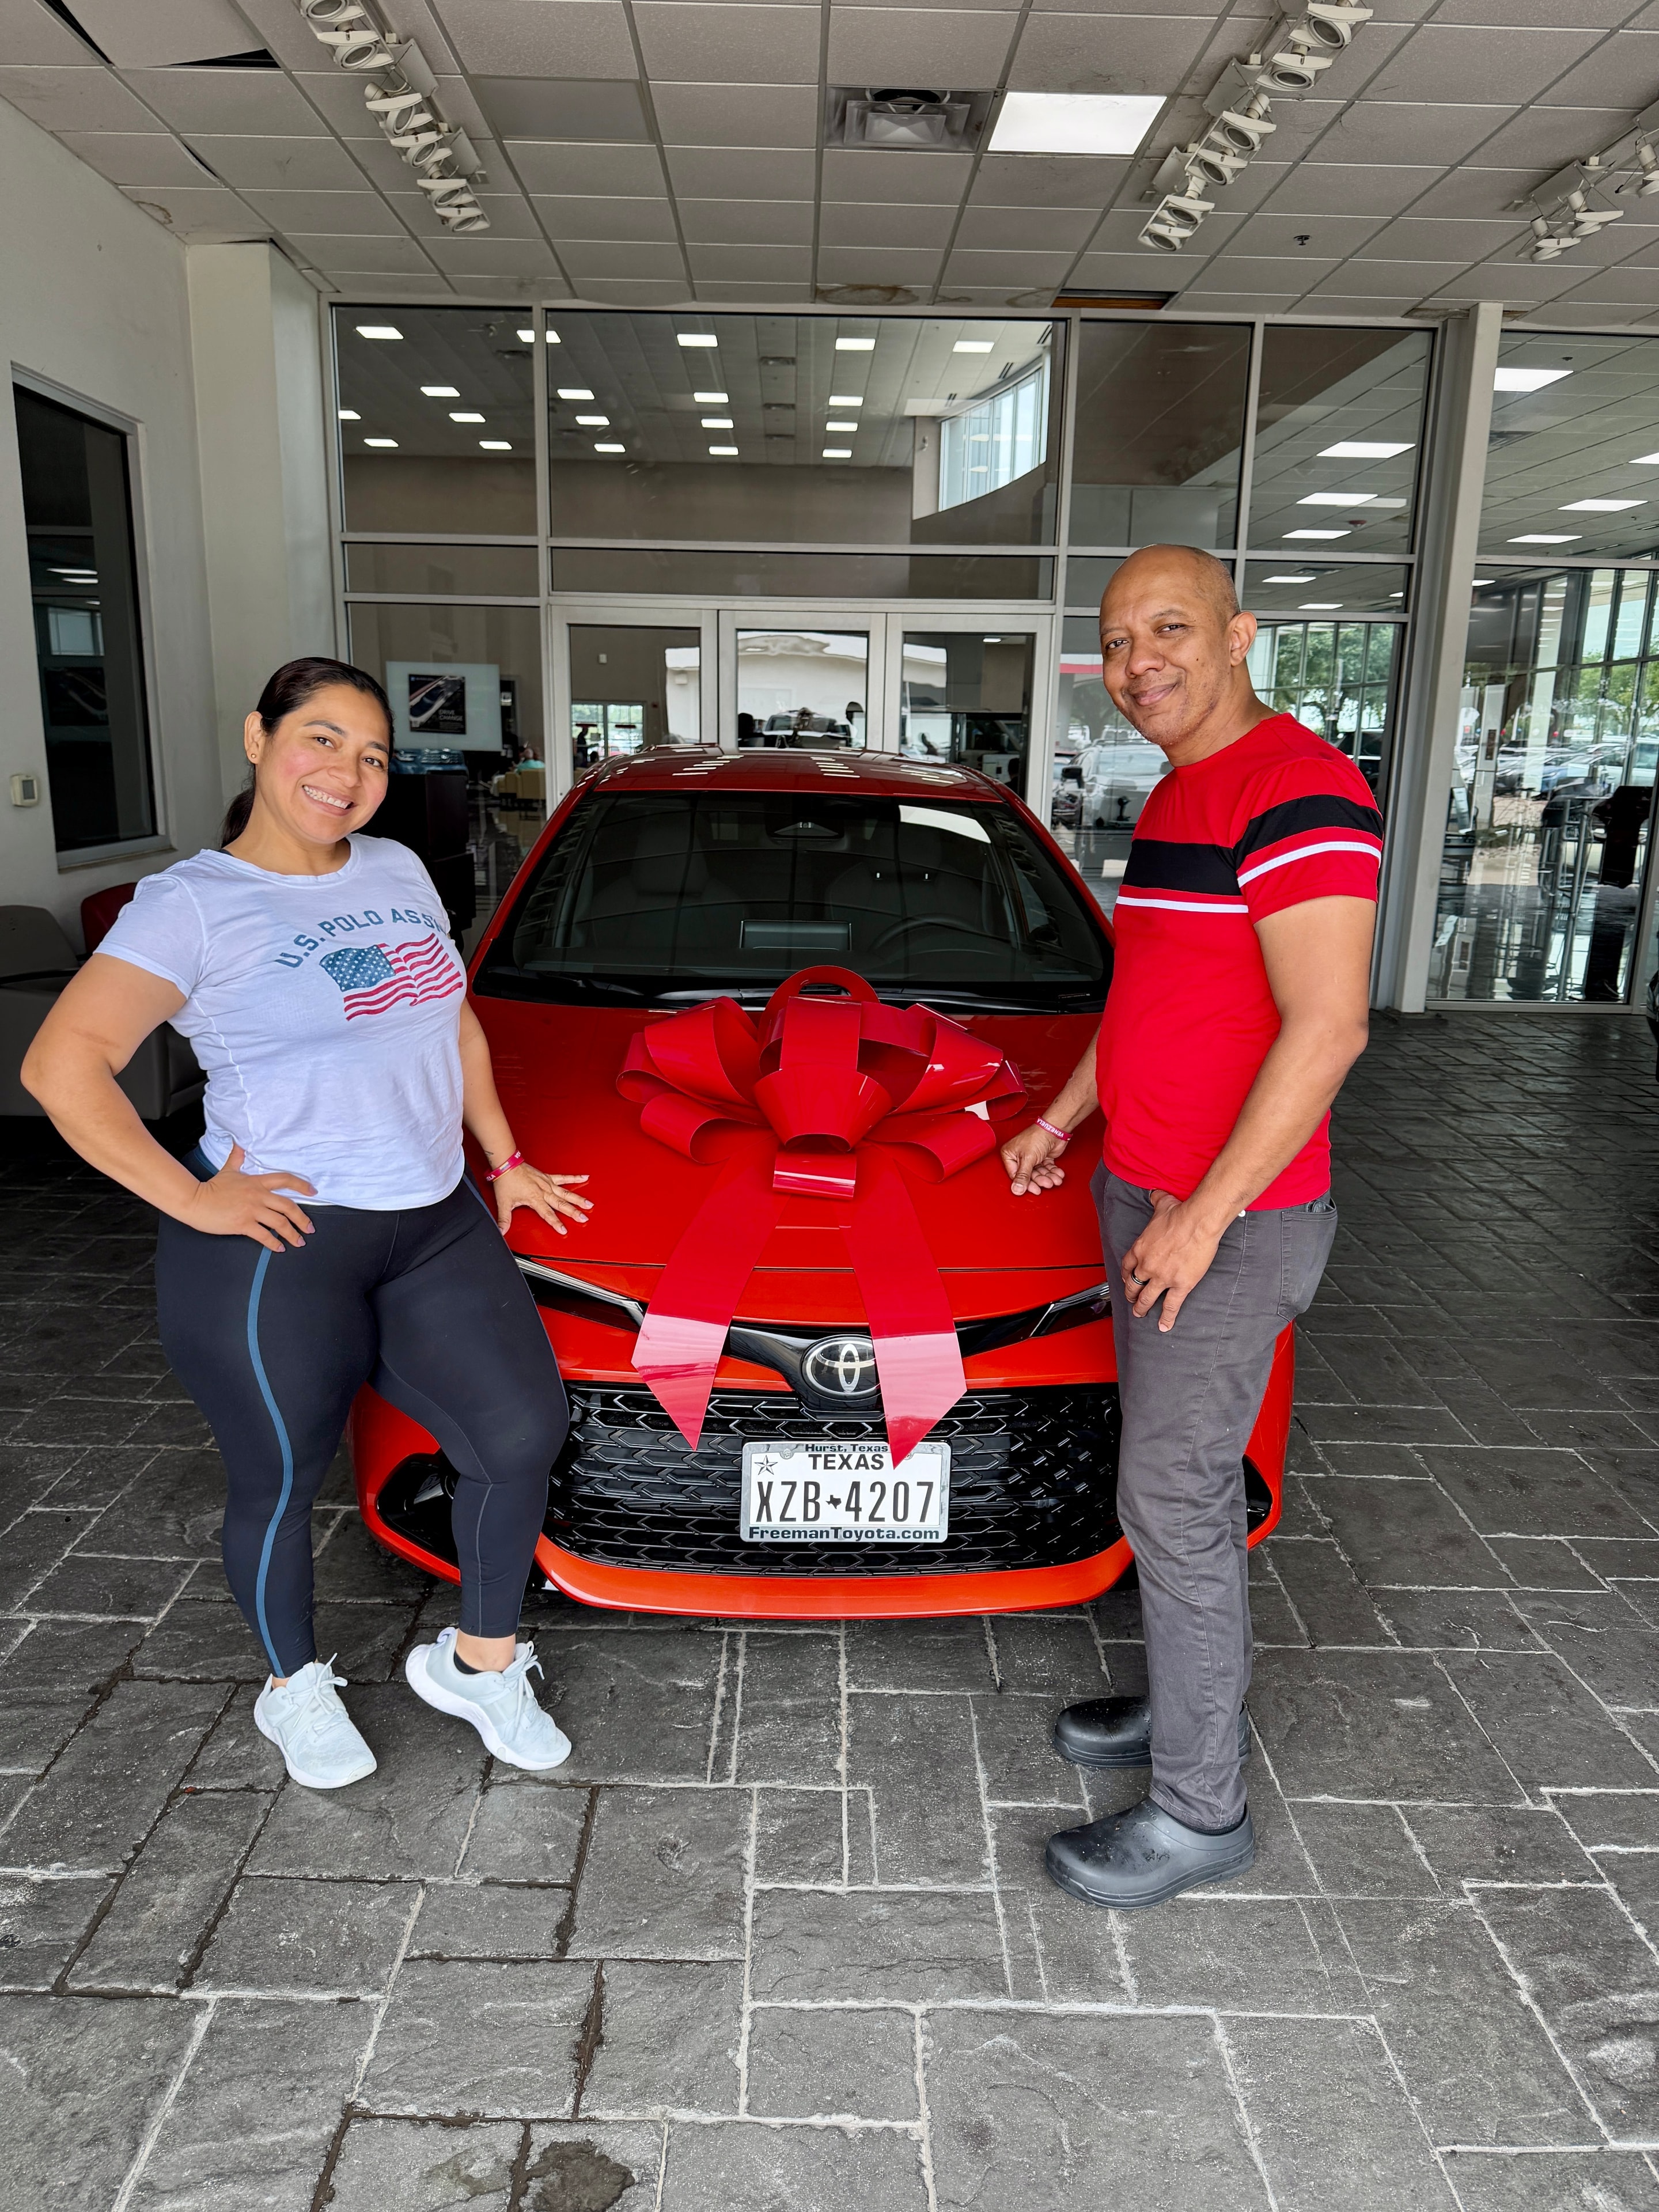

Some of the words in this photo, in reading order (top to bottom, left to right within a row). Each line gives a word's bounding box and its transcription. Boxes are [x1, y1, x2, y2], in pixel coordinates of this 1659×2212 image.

[275, 934, 326, 968] U.S.
[317, 910, 384, 937] POLO
[805, 1444, 847, 1452] Hurst,
[852, 1444, 888, 1452] Texas
[808, 1453, 884, 1470] TEXAS
[748, 1527, 940, 1541] FreemanToyota.com
